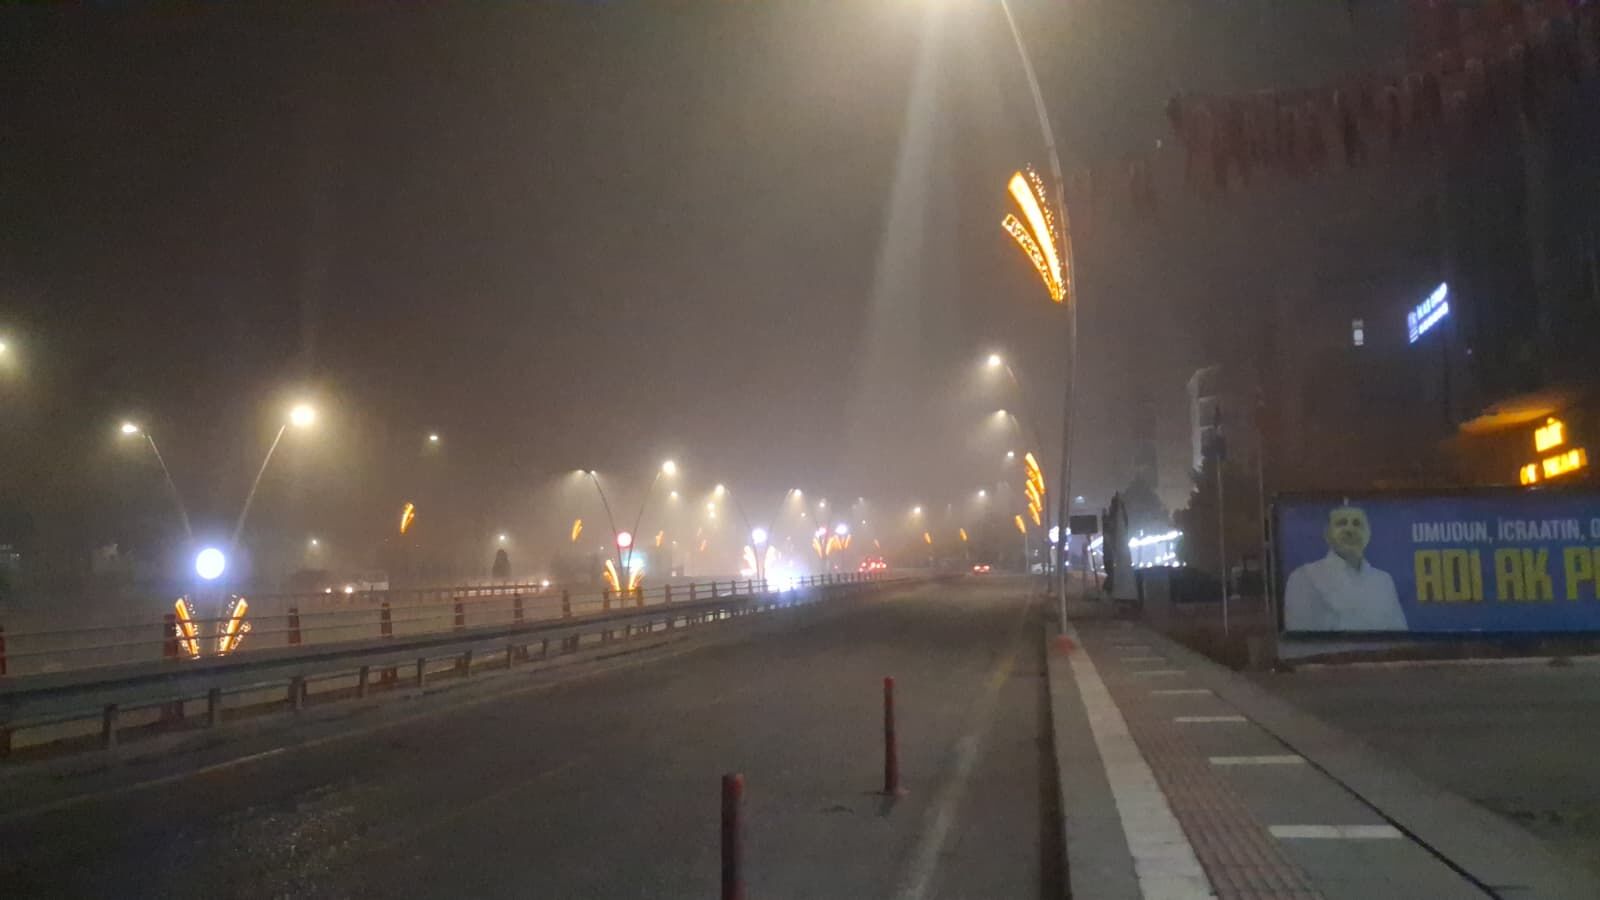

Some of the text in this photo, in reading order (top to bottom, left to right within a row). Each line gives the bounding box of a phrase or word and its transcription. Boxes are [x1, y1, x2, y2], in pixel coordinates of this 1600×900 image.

[1412, 521, 1493, 544] UMUDUN,
[1414, 549, 1483, 602] ADI
[1494, 547, 1553, 602] AK
